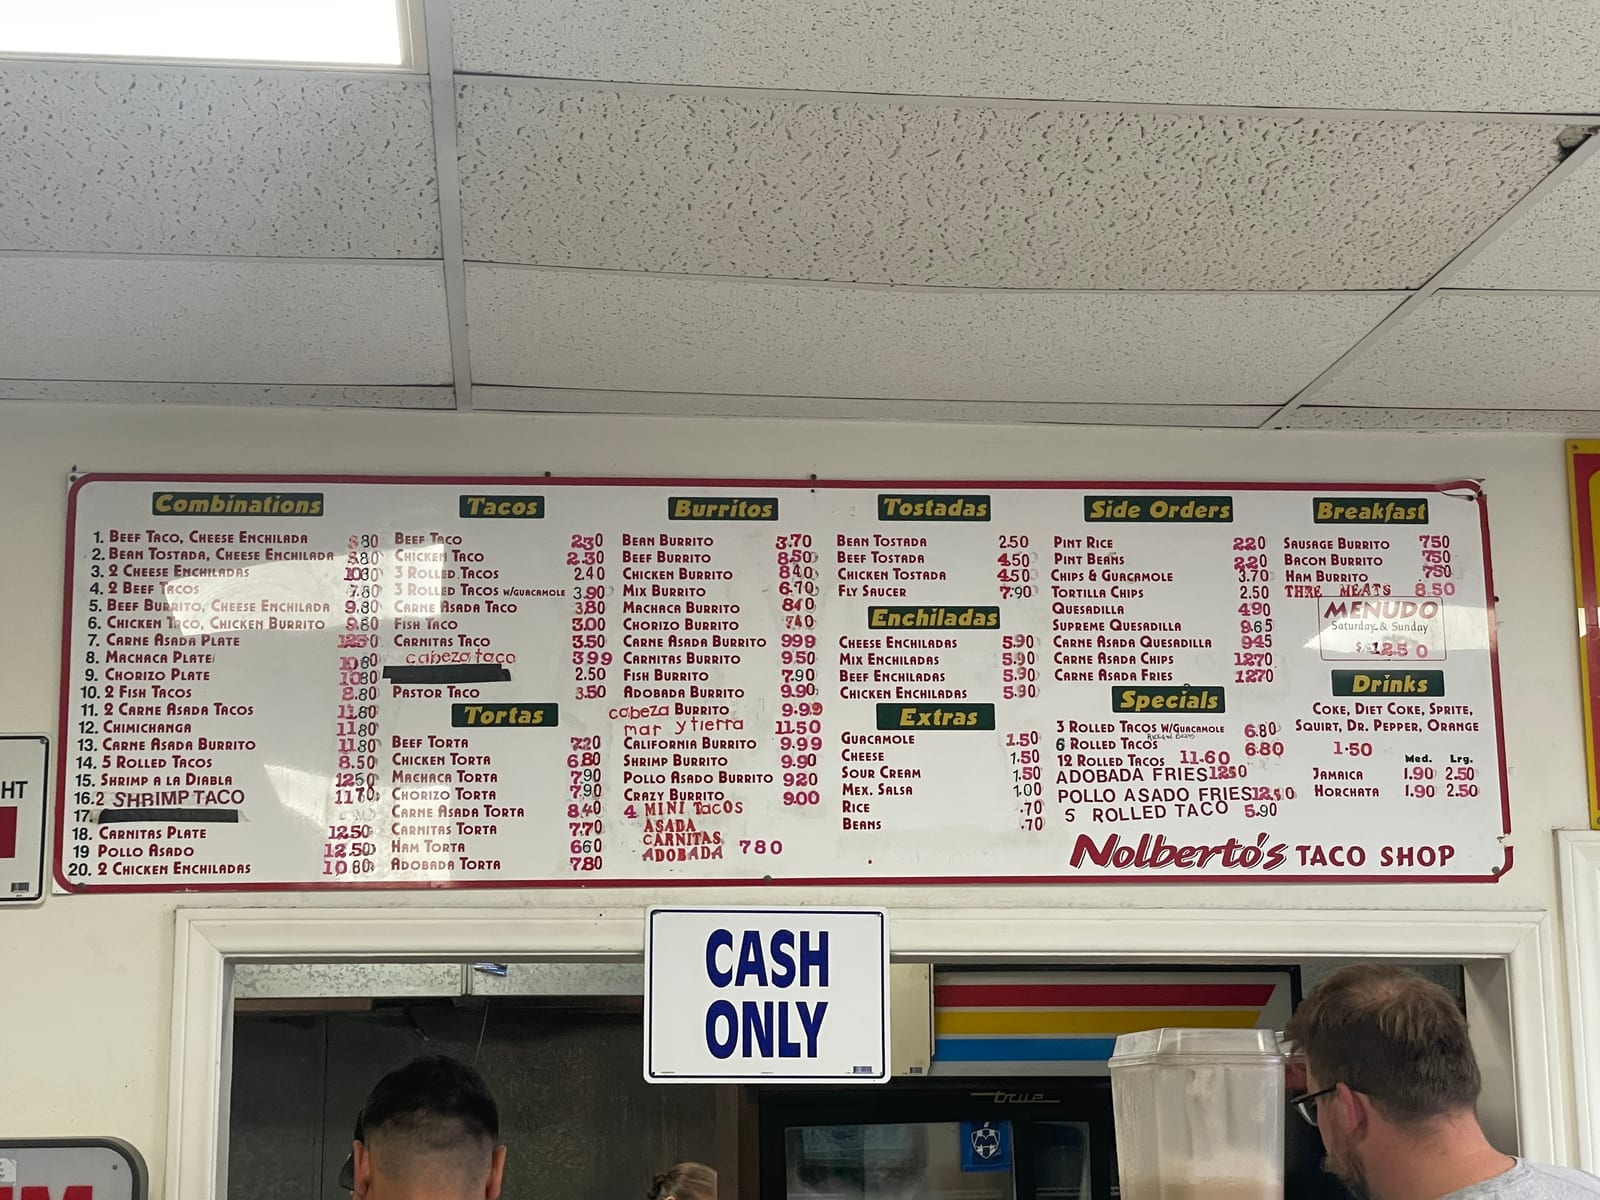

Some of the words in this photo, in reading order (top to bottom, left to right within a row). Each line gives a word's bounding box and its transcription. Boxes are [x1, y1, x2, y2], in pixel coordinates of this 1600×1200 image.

[156, 492, 322, 513] Combinations
[468, 498, 537, 515] Tacos
[675, 500, 772, 517] Burritos
[884, 498, 986, 516] Tostadas
[1090, 501, 1140, 518] Side
[1150, 501, 1230, 518] Orders
[1317, 502, 1425, 522] Breakfast
[94, 531, 103, 543] 1.
[872, 608, 997, 626] Enchiladas
[1324, 599, 1440, 619] MENUDO
[1331, 621, 1375, 633] Saturday
[1380, 621, 1388, 631] &
[1392, 621, 1428, 634] Sunday
[85, 669, 98, 681] 9.
[1353, 675, 1427, 692] Drinks
[81, 686, 100, 699] 10.
[1121, 690, 1217, 711] Specials
[465, 706, 543, 724] Tortas
[609, 705, 669, 720] cabeza
[900, 708, 977, 726] Extras
[79, 721, 98, 734] 12.
[76, 756, 96, 769] 14.
[1405, 754, 1432, 762] Med.
[1450, 754, 1473, 765] Lrg.
[1056, 768, 1143, 784] ADOBADA
[1153, 767, 1210, 781] FRIES
[1093, 804, 1167, 823] ROLLED
[1175, 800, 1229, 818] TACO
[72, 828, 92, 840] 18.
[1070, 833, 1288, 871] Nolberto's
[1296, 845, 1365, 866] TACO
[1381, 845, 1454, 867] SHOP
[68, 863, 91, 876] 20.
[706, 929, 828, 988] CASH
[706, 1000, 828, 1059] ONLY
